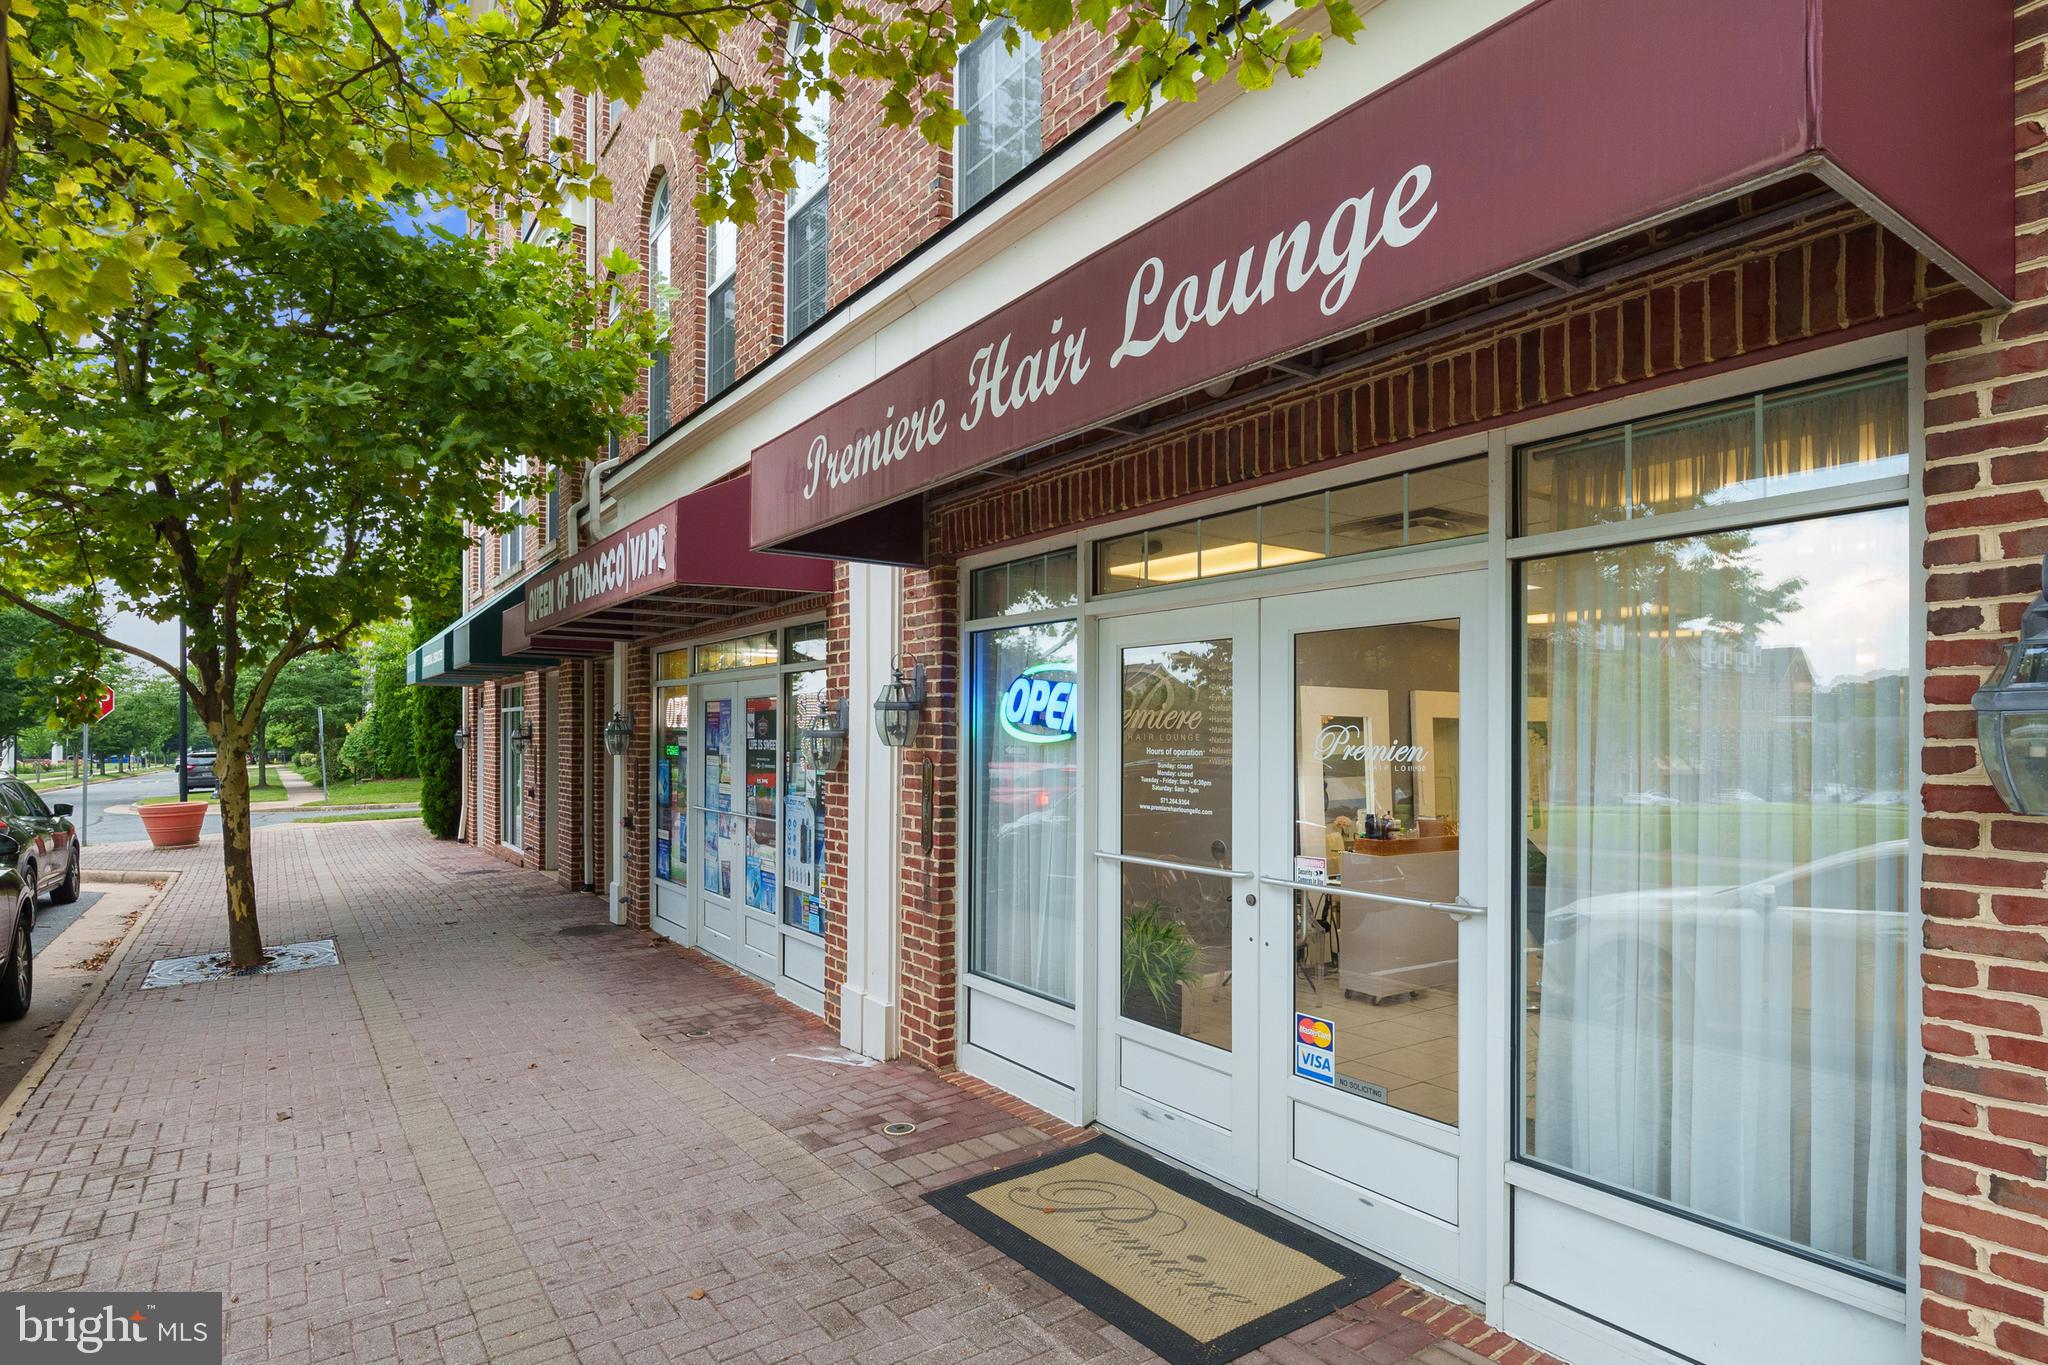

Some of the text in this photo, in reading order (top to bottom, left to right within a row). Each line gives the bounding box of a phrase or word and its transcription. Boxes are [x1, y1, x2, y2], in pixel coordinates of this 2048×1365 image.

[802, 164, 1439, 500] Premiere Hair Lounge
[528, 579, 554, 622] QUEEN
[557, 571, 569, 611] OF
[1128, 733, 1200, 742] HAIR LOUNGE
[1146, 747, 1165, 756] Hours
[1165, 747, 1172, 756] of
[1301, 1050, 1331, 1073] VISA
[1339, 1078, 1382, 1098] NO SOLICITING
